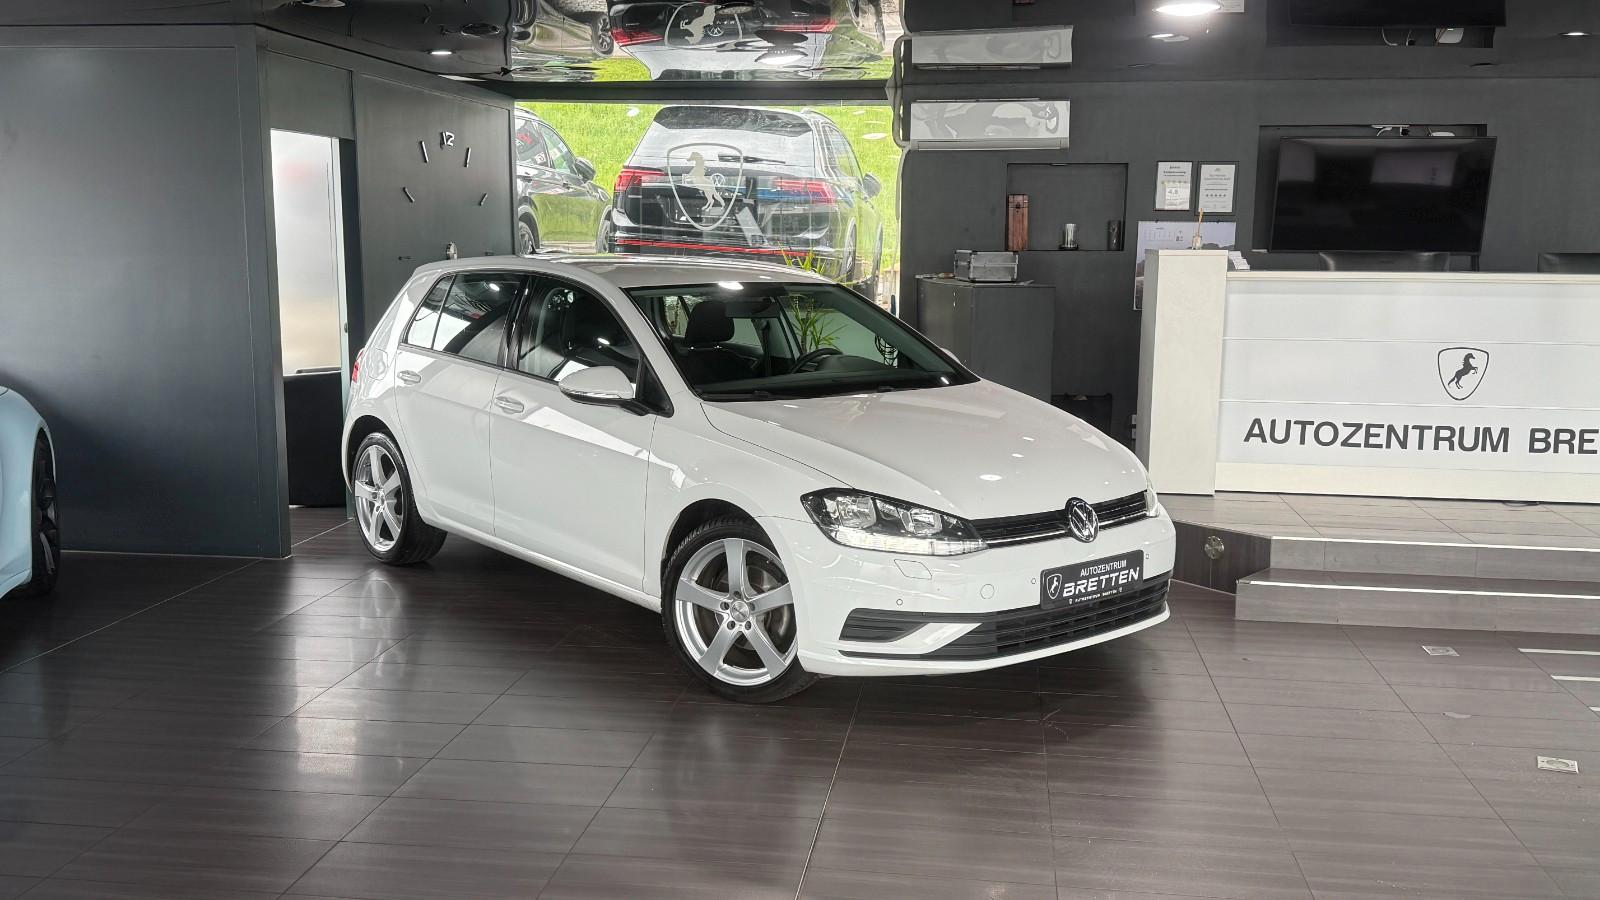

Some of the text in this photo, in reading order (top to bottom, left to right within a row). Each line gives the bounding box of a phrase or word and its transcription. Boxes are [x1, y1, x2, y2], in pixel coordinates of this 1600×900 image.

[441, 131, 455, 146] 12
[1243, 417, 1600, 455] AUTOZENTRUM BRE
[1080, 559, 1127, 577] AUTOZENTRUM
[1062, 566, 1140, 597] BRETTEN
